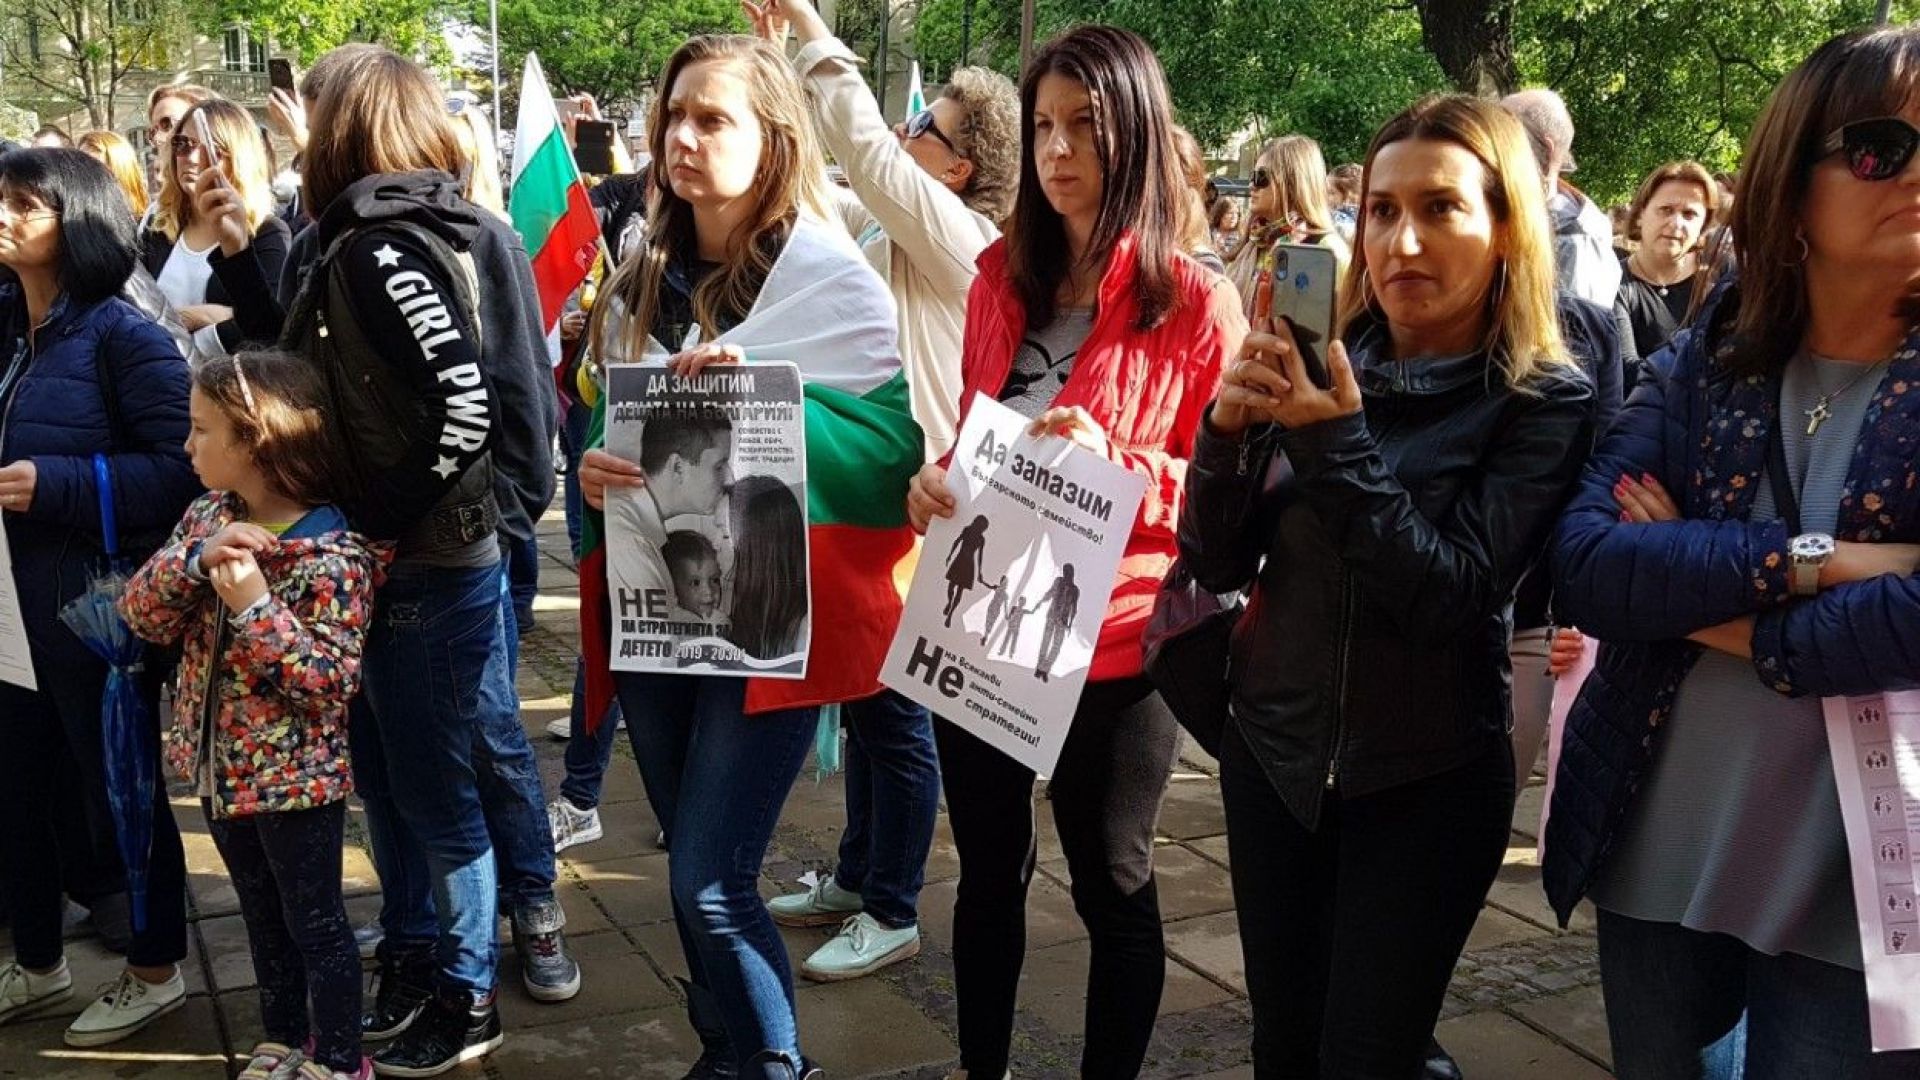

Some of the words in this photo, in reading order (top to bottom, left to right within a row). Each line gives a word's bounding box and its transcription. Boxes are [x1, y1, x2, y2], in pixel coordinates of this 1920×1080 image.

[385, 270, 461, 361] GIRL
[436, 362, 491, 453] PWR
[646, 374, 668, 397] ДА
[671, 373, 755, 397] ЗАЩИТИМ
[614, 401, 670, 423] ДЕЦАТА
[676, 401, 697, 421] НА
[702, 401, 793, 421] БЪЛГАРИЯ!
[975, 429, 1008, 466] Да
[1011, 453, 1114, 523] запазим
[971, 465, 1036, 510] Българското
[1038, 505, 1104, 545] семейство!
[618, 588, 669, 618] НЕ
[621, 619, 636, 633] НА
[638, 620, 713, 636] СТРАТЕГИЯТА
[620, 639, 673, 658] ДЕТЕТО
[675, 647, 702, 659] 2019
[906, 635, 964, 699] Не
[944, 650, 957, 662] на
[959, 656, 1002, 688] всякакви
[965, 698, 1041, 748] стратегии!
[969, 681, 1038, 726] анти-семейни
